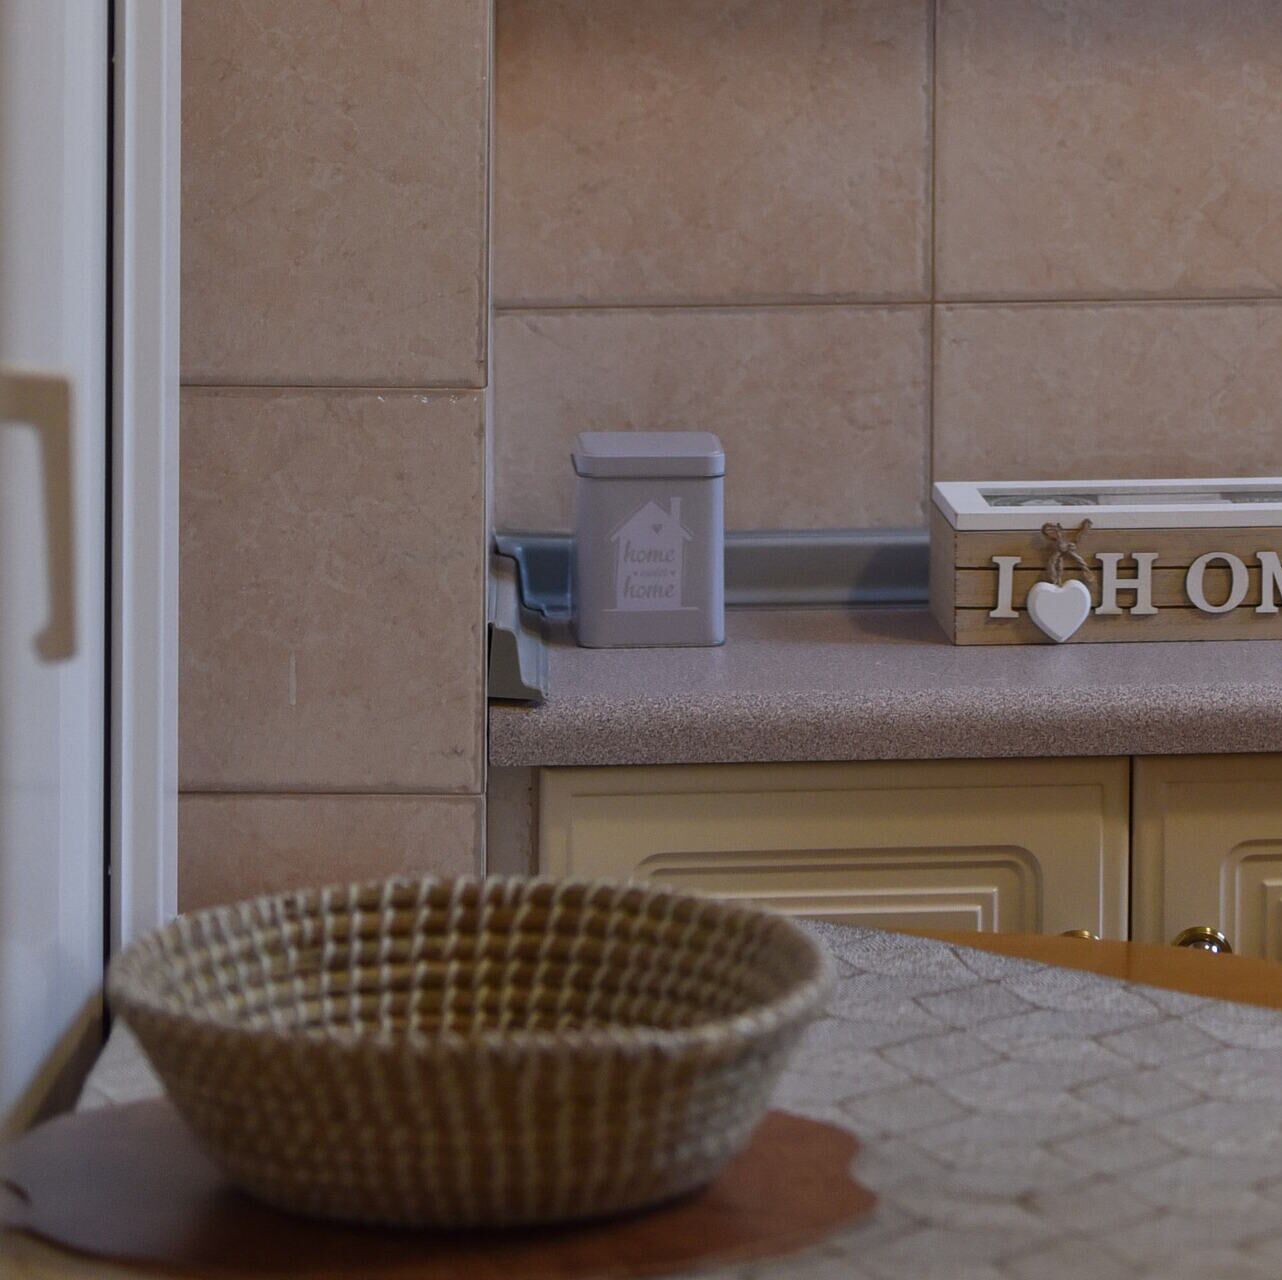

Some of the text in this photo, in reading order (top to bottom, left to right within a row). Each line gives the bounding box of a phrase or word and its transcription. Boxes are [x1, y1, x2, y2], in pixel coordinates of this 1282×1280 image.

[624, 539, 675, 562] home
[624, 576, 674, 598] home
[989, 555, 1021, 618] I
